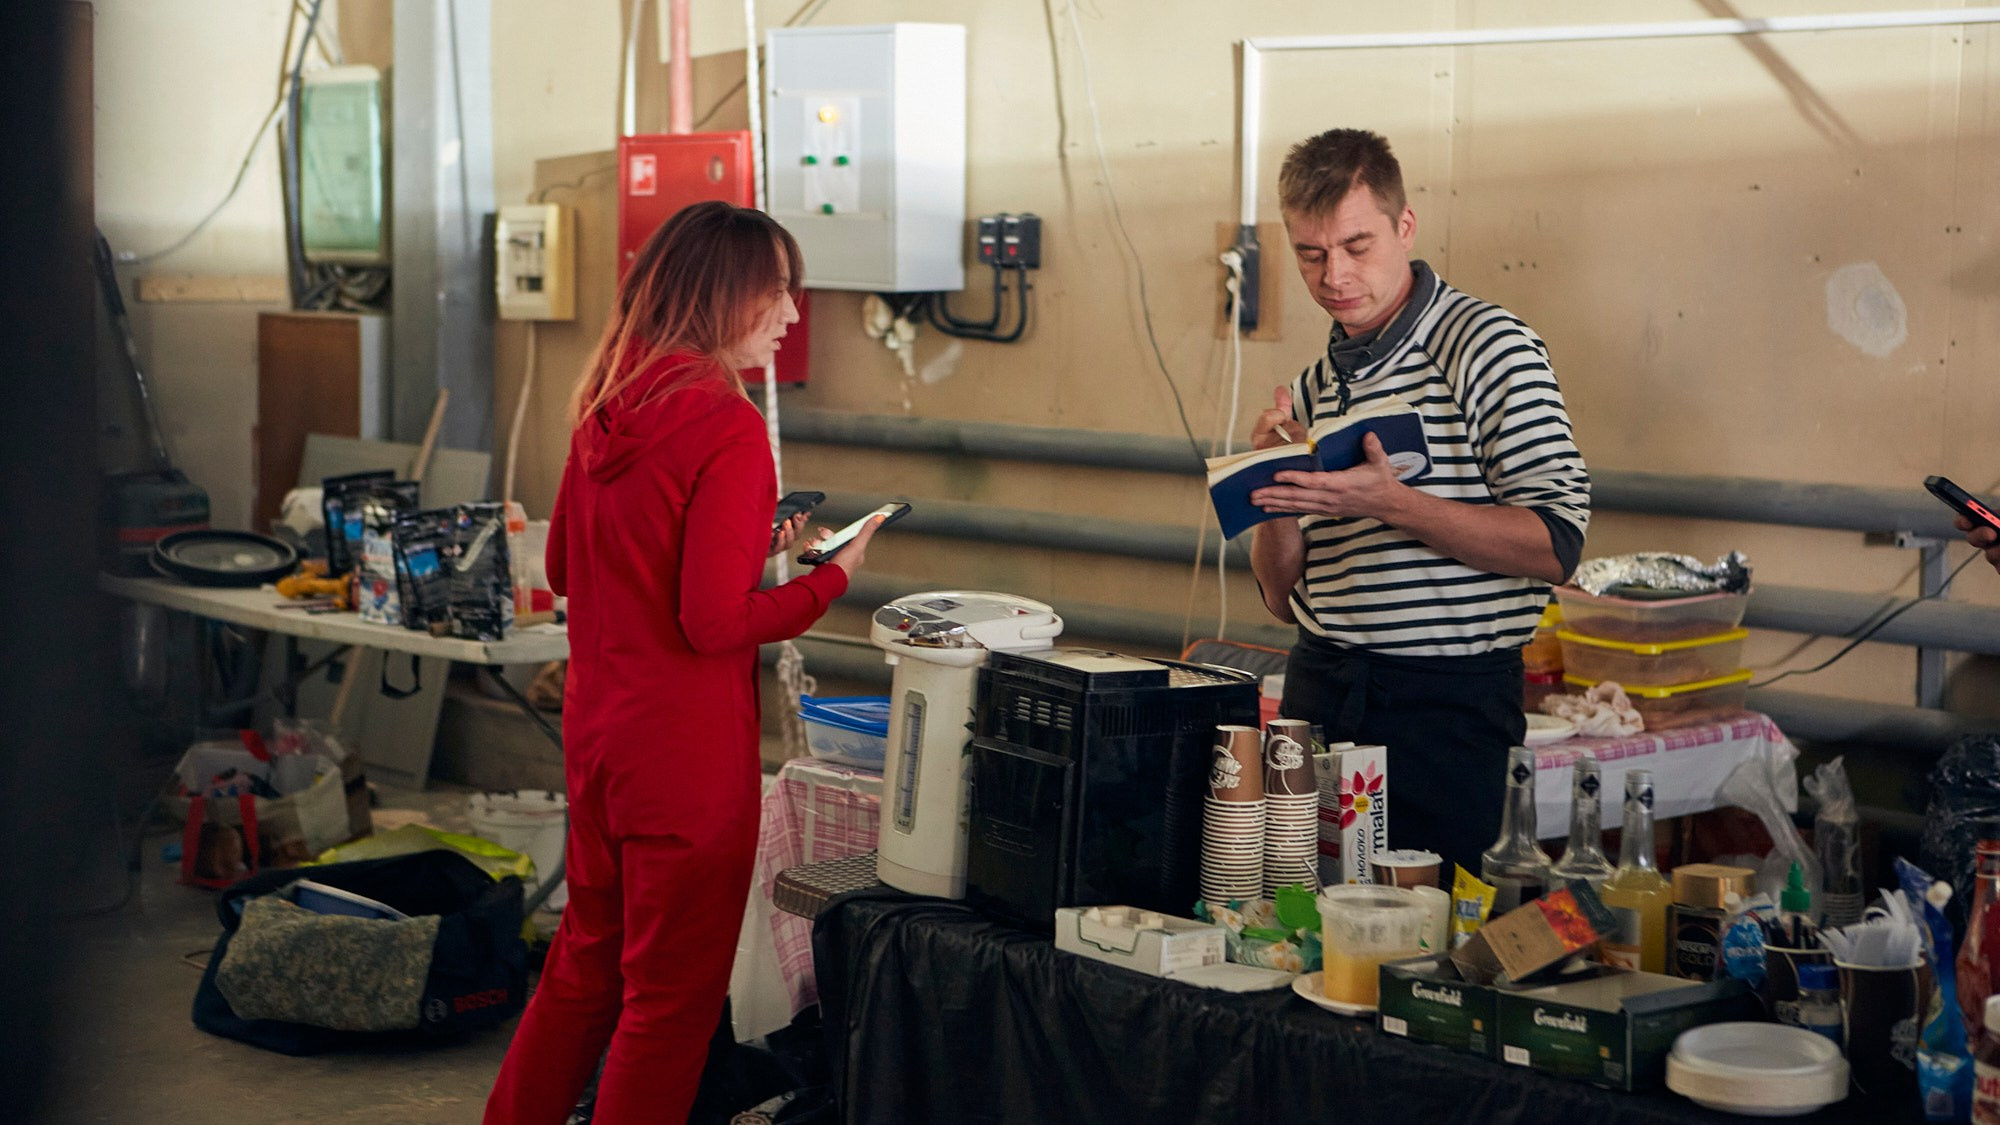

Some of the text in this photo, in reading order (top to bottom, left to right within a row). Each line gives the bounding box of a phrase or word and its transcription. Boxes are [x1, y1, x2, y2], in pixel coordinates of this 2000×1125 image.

[453, 989, 508, 1014] BOSCH
[1411, 981, 1462, 1007] Greenfield
[1533, 1007, 1587, 1033] Greenfield
